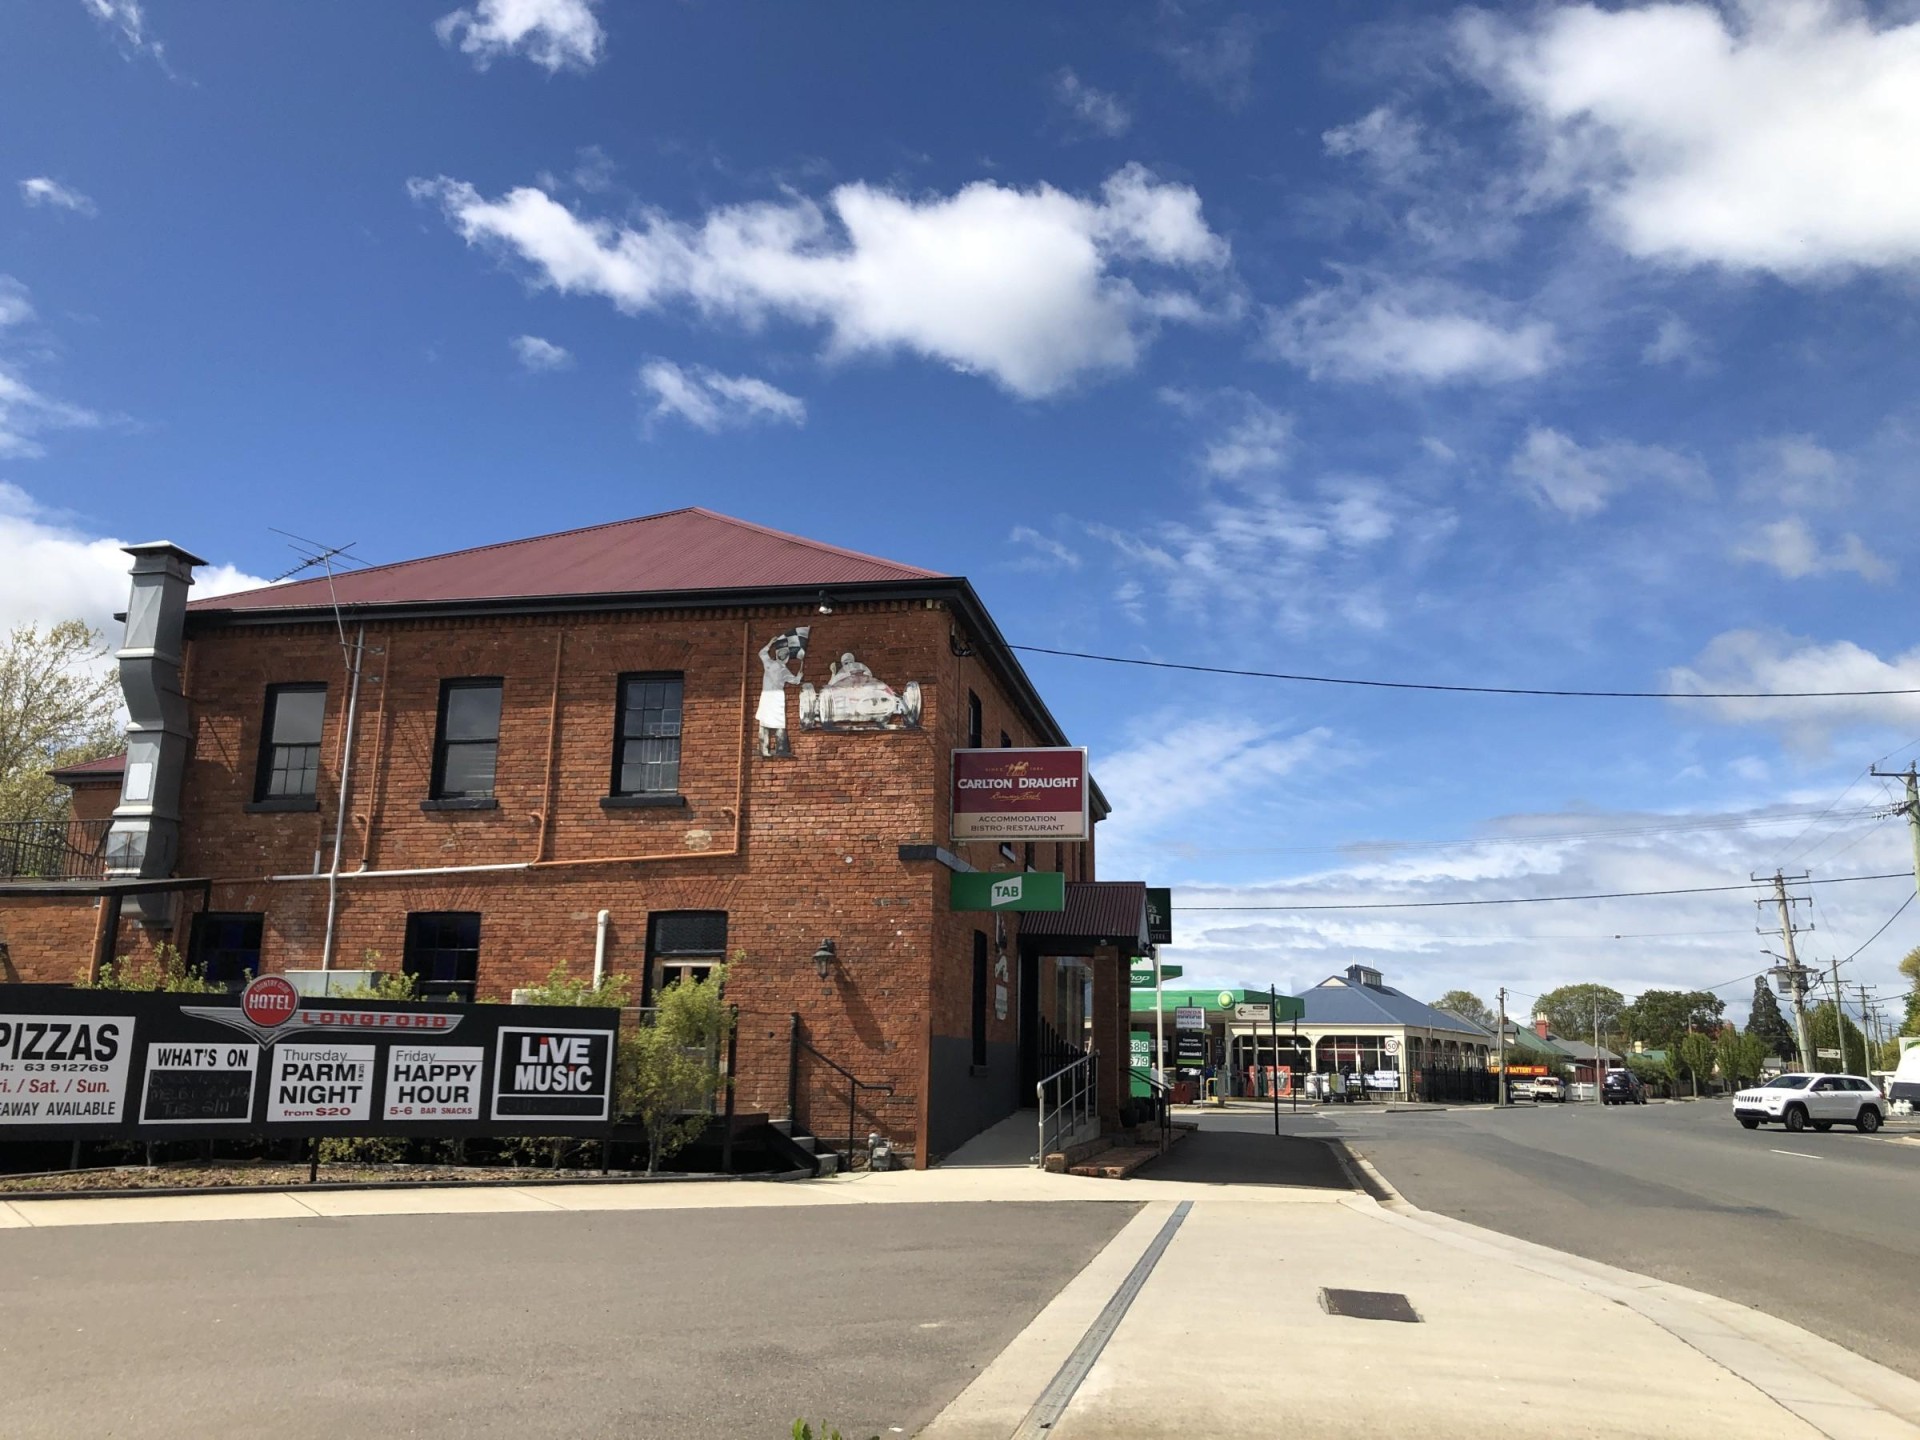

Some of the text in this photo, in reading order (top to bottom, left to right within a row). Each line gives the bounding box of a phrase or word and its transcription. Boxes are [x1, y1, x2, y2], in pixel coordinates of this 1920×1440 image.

[957, 777, 1079, 789] CARLTON DRAUGHT
[978, 815, 1057, 823] ACCOMMODATION
[994, 886, 1019, 897] TAB
[249, 993, 291, 1010] HOTEL
[302, 1011, 447, 1027] LONGFORD
[0, 1023, 119, 1062] PIZZAS
[157, 1048, 248, 1067] WHAT'S ON
[283, 1049, 348, 1064] Thursday
[396, 1050, 436, 1064] Friday
[0, 1063, 109, 1072] h: 63 912769
[281, 1063, 357, 1082] PARM
[393, 1064, 477, 1082] HAPPY
[28, 1079, 60, 1093] Sat.
[76, 1079, 110, 1093] Sun.
[279, 1085, 363, 1104] NIGHT
[398, 1086, 469, 1104] HOUR
[0, 1102, 116, 1117] AWAY AVAILABLE
[315, 1107, 351, 1117] $20
[389, 1107, 473, 1116] 5-6 BAR SNACKS
